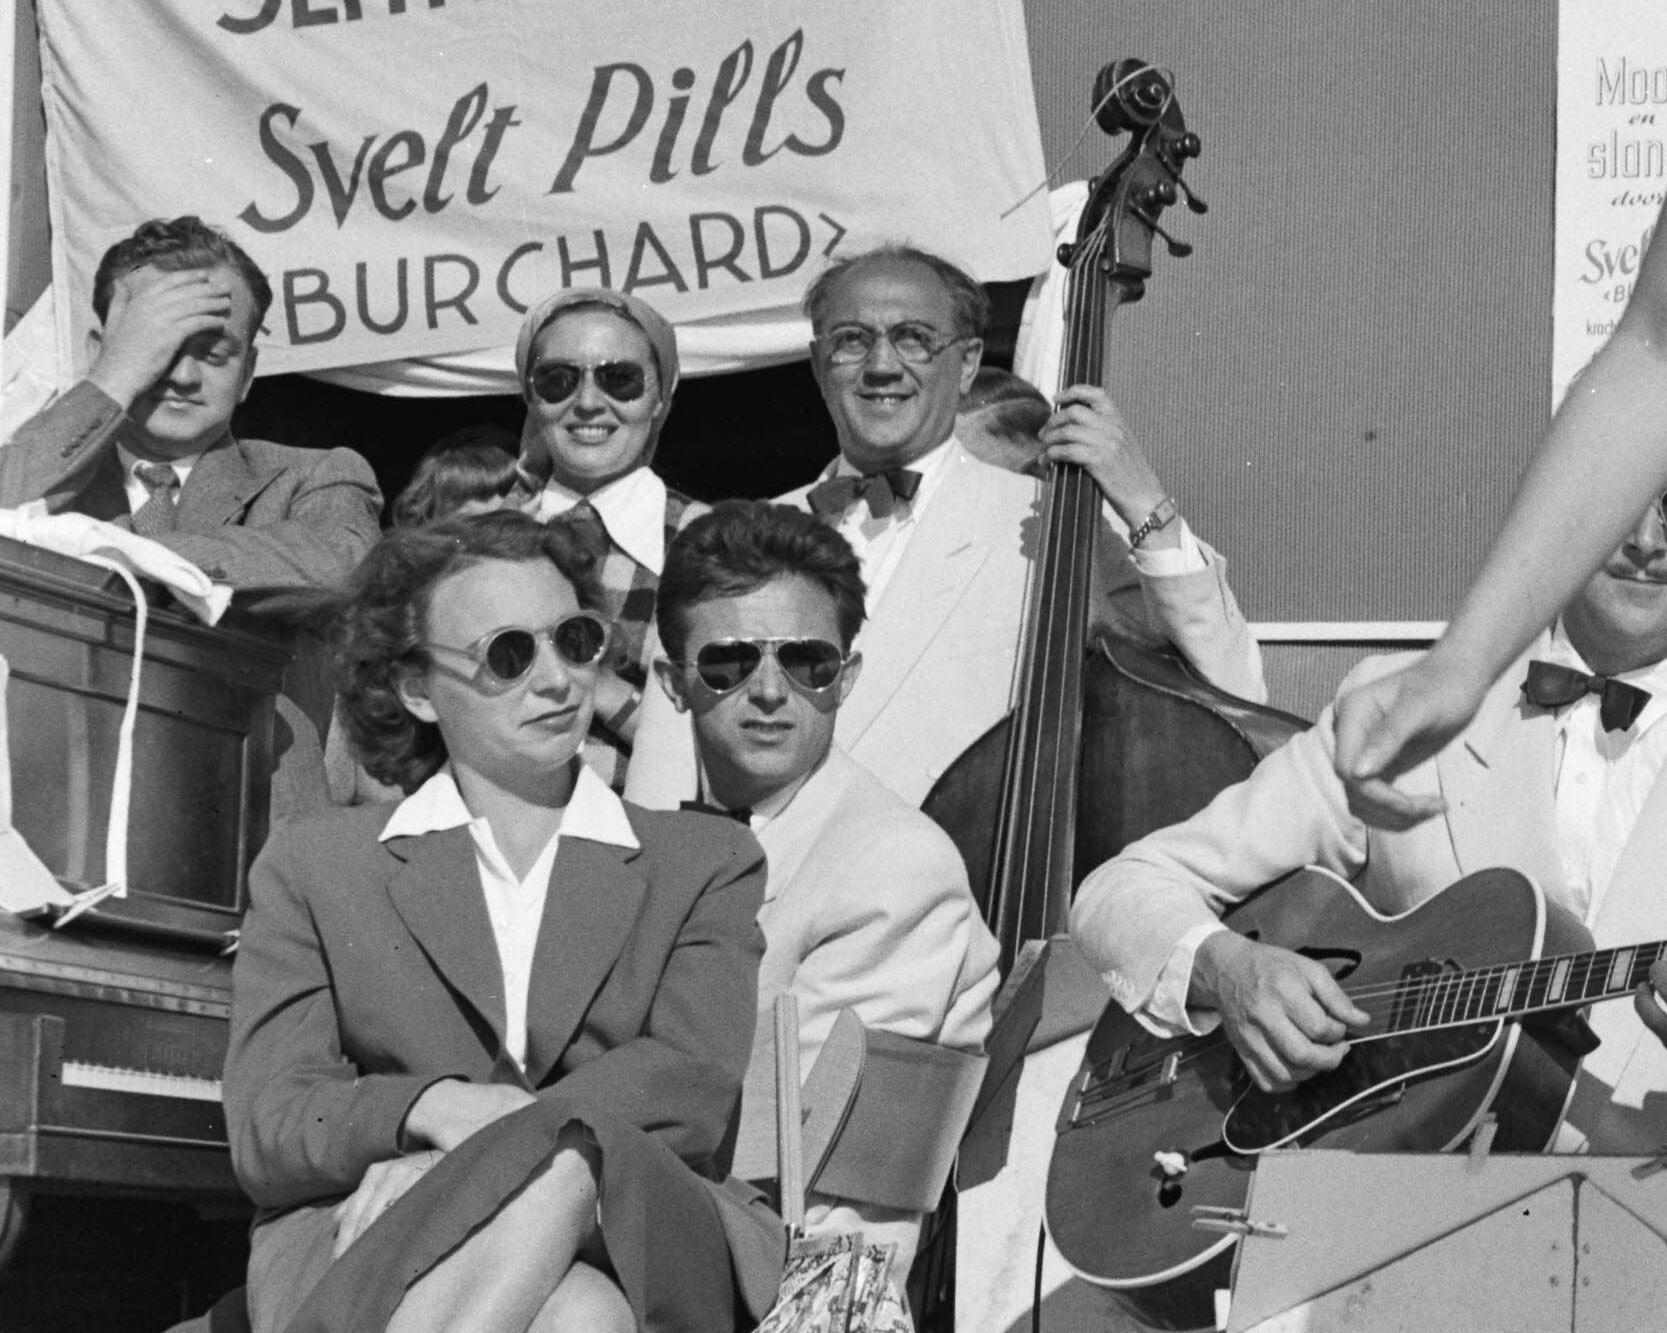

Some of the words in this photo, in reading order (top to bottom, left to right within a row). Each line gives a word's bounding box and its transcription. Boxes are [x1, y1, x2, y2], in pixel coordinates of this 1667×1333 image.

[1628, 113, 1656, 125] en
[238, 82, 523, 234] Svelt
[545, 27, 847, 196] Pills
[1611, 190, 1665, 207] door
